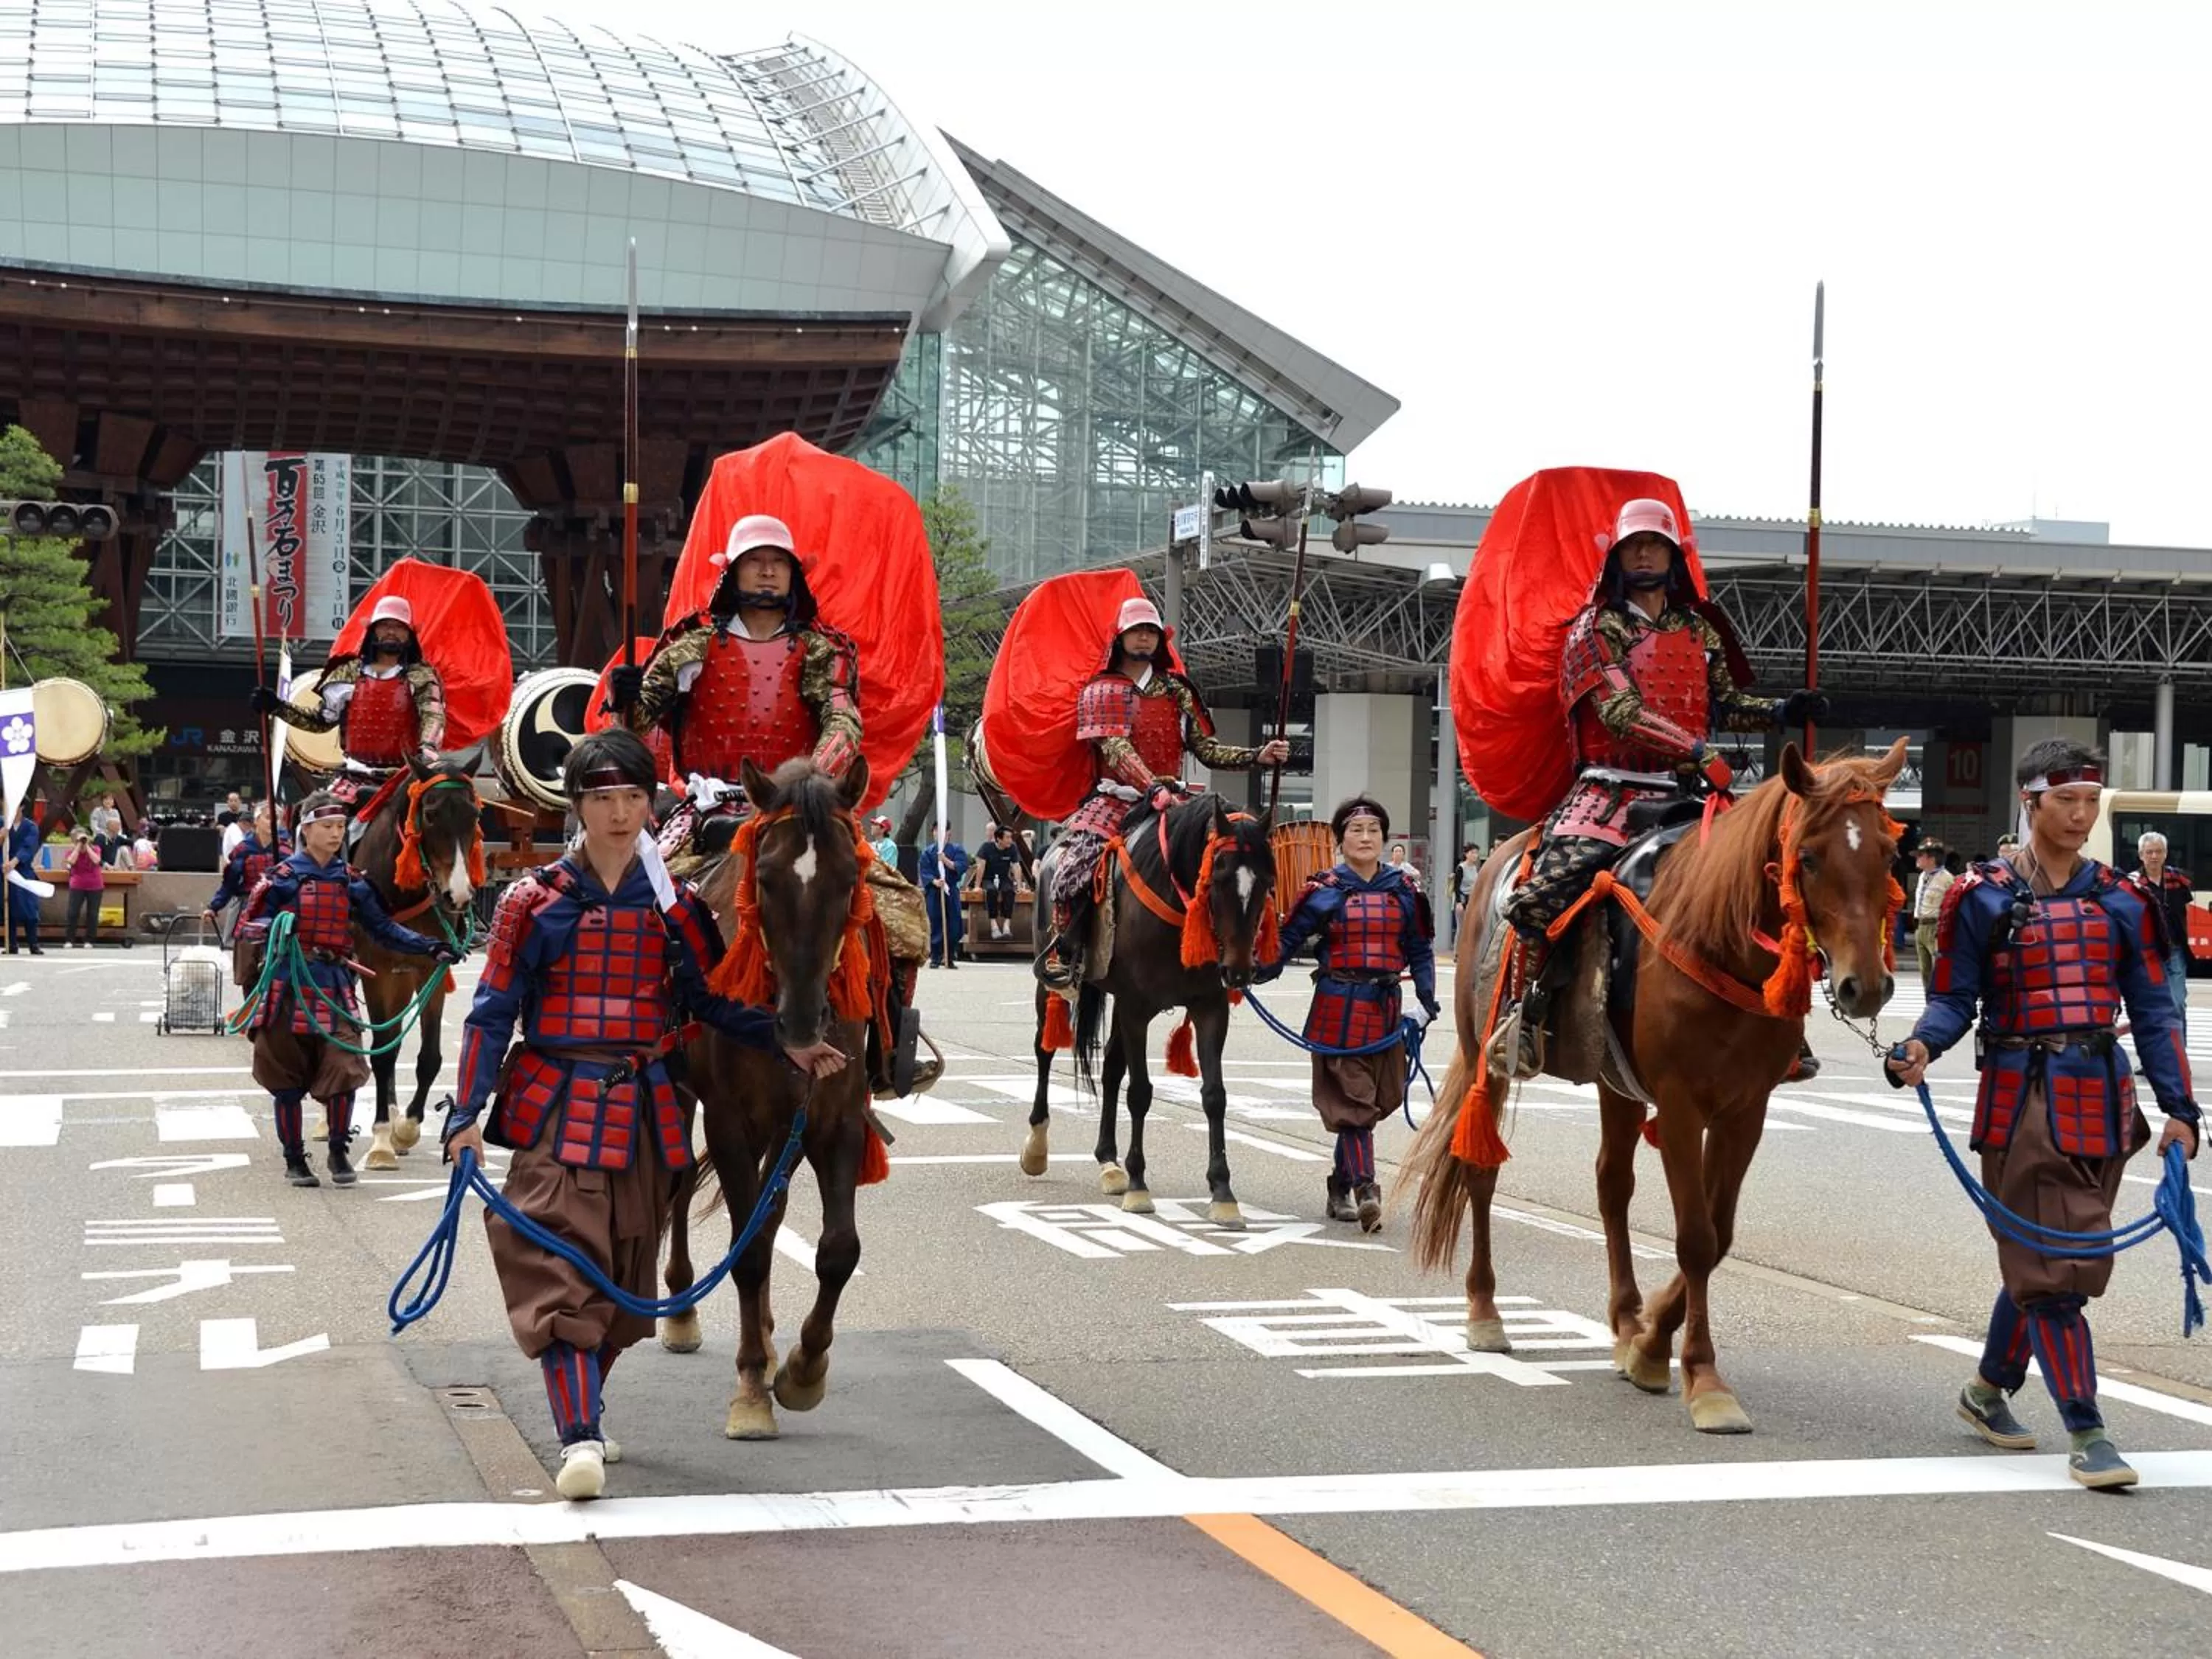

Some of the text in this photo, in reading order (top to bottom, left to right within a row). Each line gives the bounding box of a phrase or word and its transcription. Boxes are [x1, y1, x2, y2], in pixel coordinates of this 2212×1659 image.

[312, 459, 327, 534] 第65回 金沢
[264, 458, 307, 628] 百万石まつり
[170, 727, 203, 746] JR
[206, 744, 258, 754] KANAZAWA
[1950, 748, 1978, 780] 10
